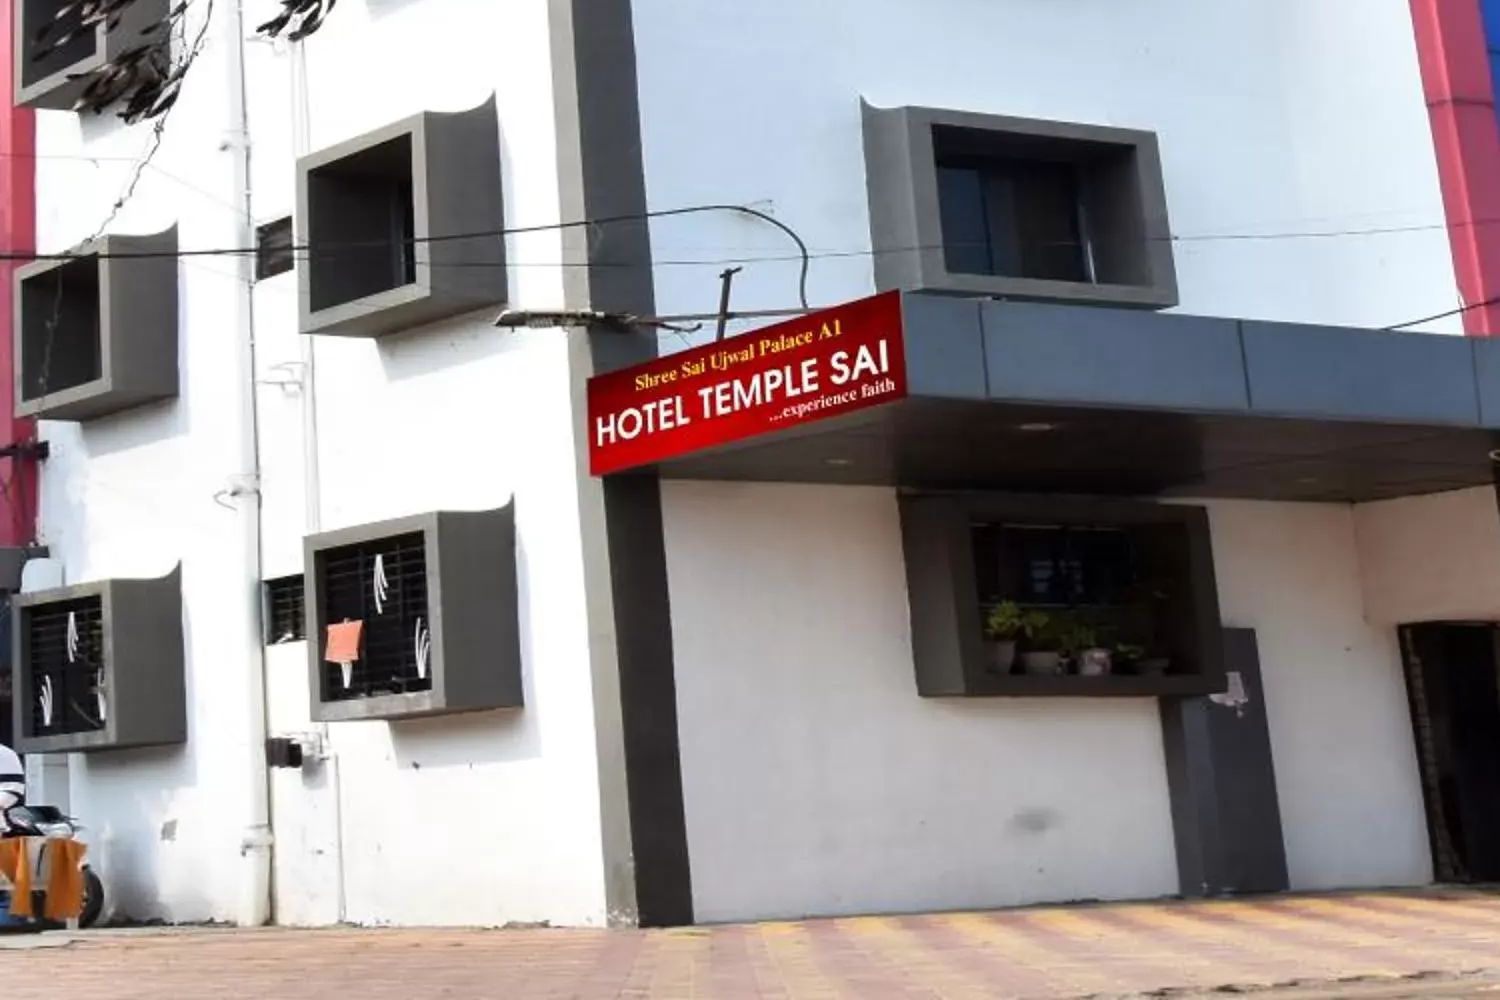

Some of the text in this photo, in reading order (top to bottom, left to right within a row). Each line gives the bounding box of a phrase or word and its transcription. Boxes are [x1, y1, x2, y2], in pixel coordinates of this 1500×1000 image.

[634, 319, 842, 391] Shree Sai Ujwal Palace A1
[596, 339, 890, 447] HOTEL TEMPLE SAI
[768, 378, 896, 422] ...experience faith
